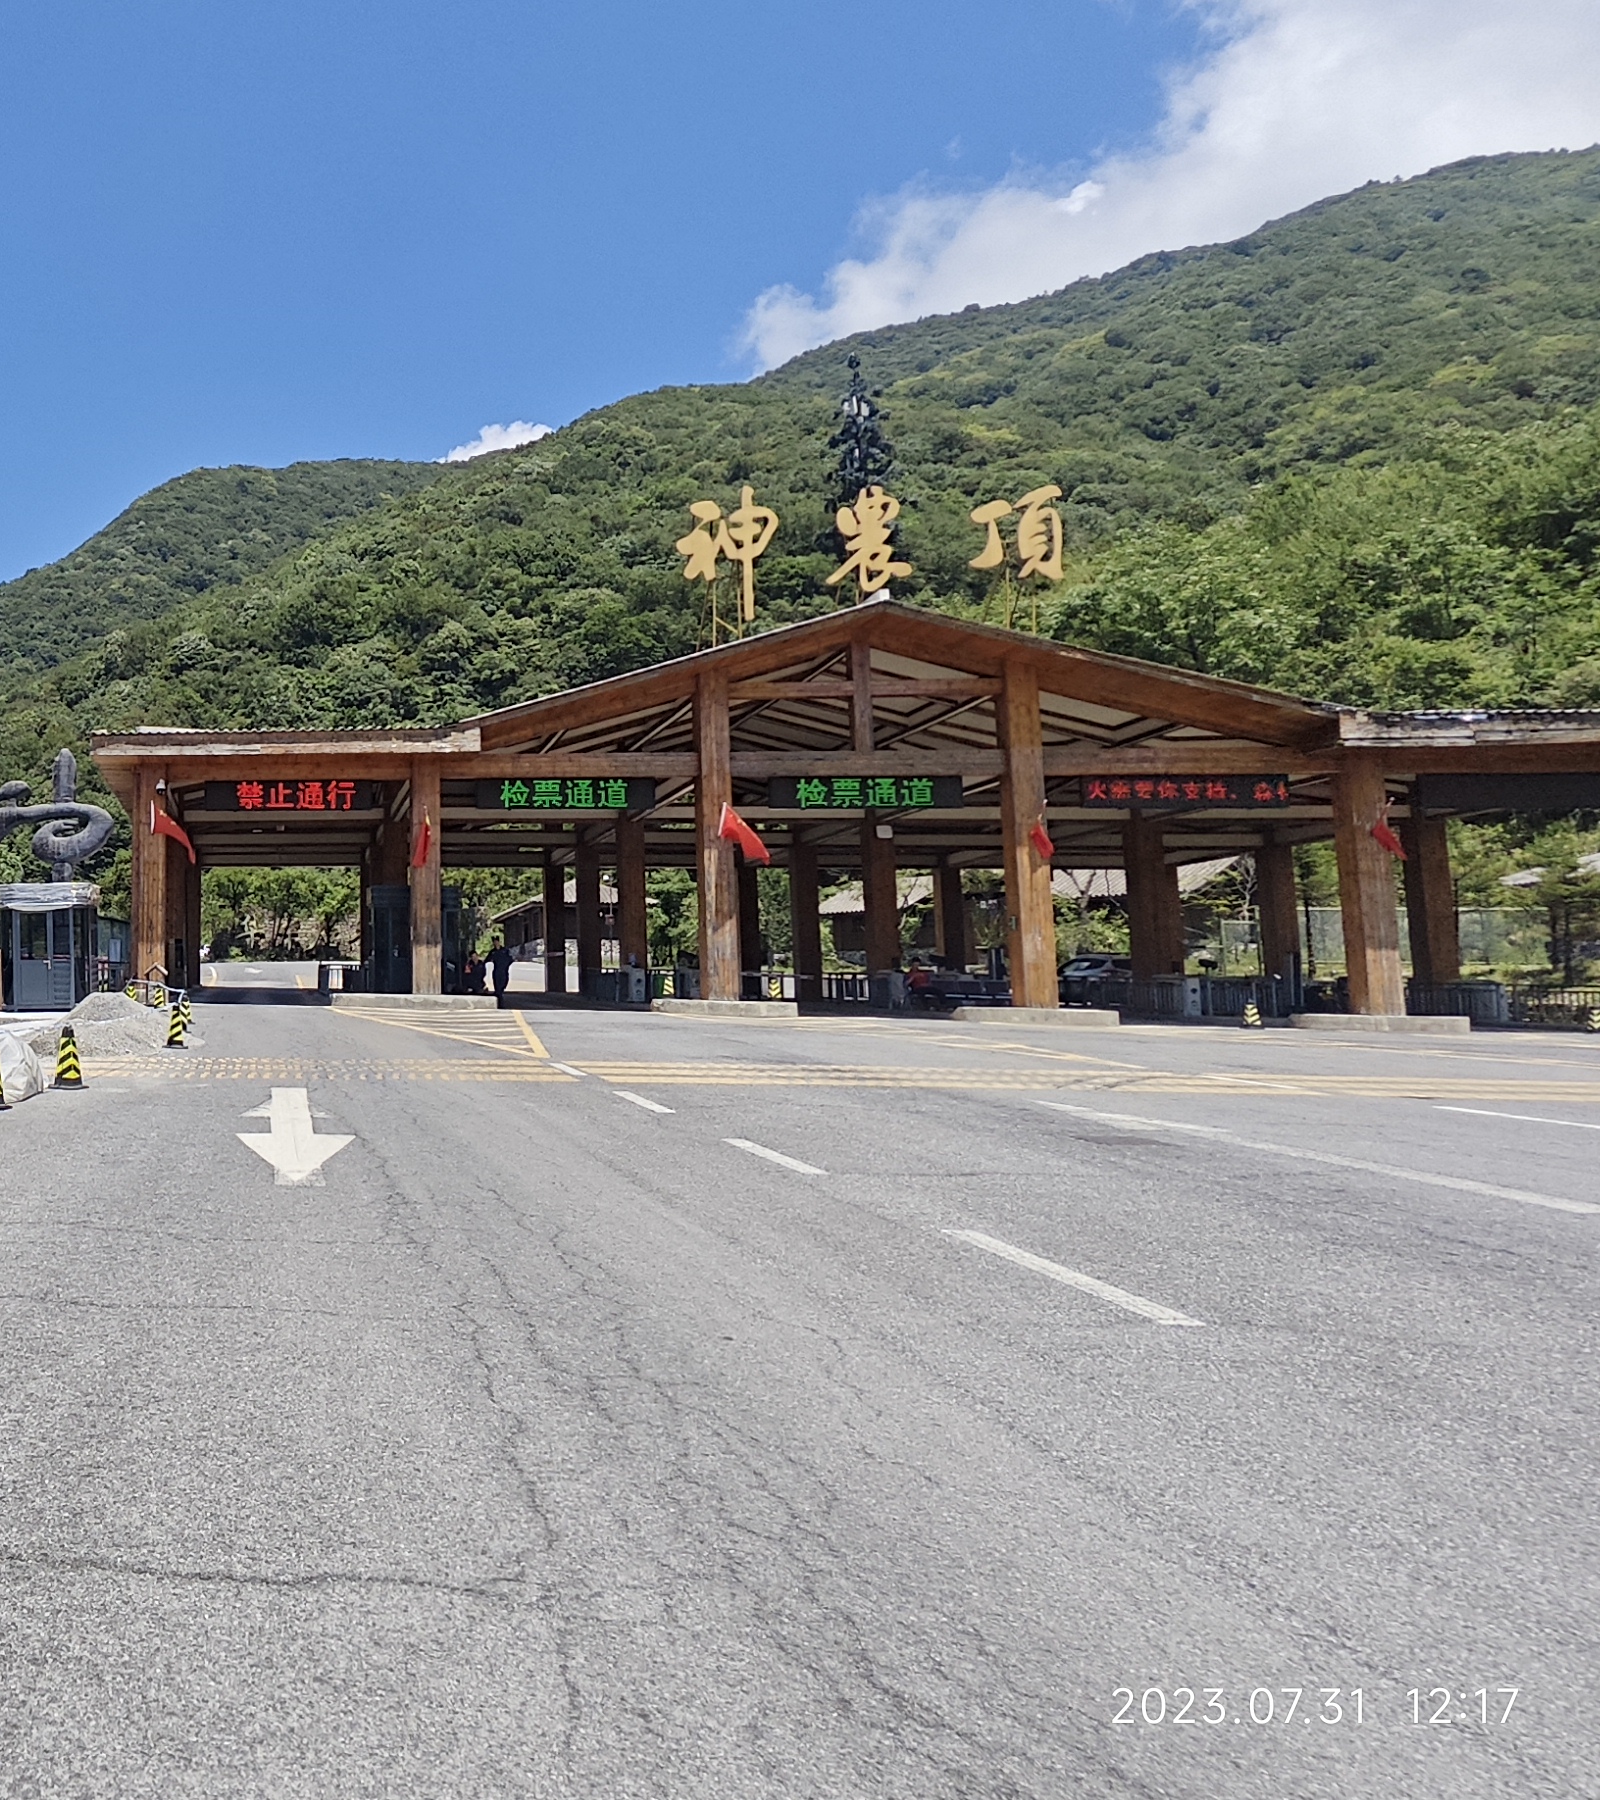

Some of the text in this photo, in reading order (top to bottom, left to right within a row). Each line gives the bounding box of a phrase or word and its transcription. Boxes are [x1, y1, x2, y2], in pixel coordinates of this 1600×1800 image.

[237, 780, 356, 810] 禁止通行
[500, 780, 628, 810] 检票通道
[796, 778, 934, 809] 检票通道
